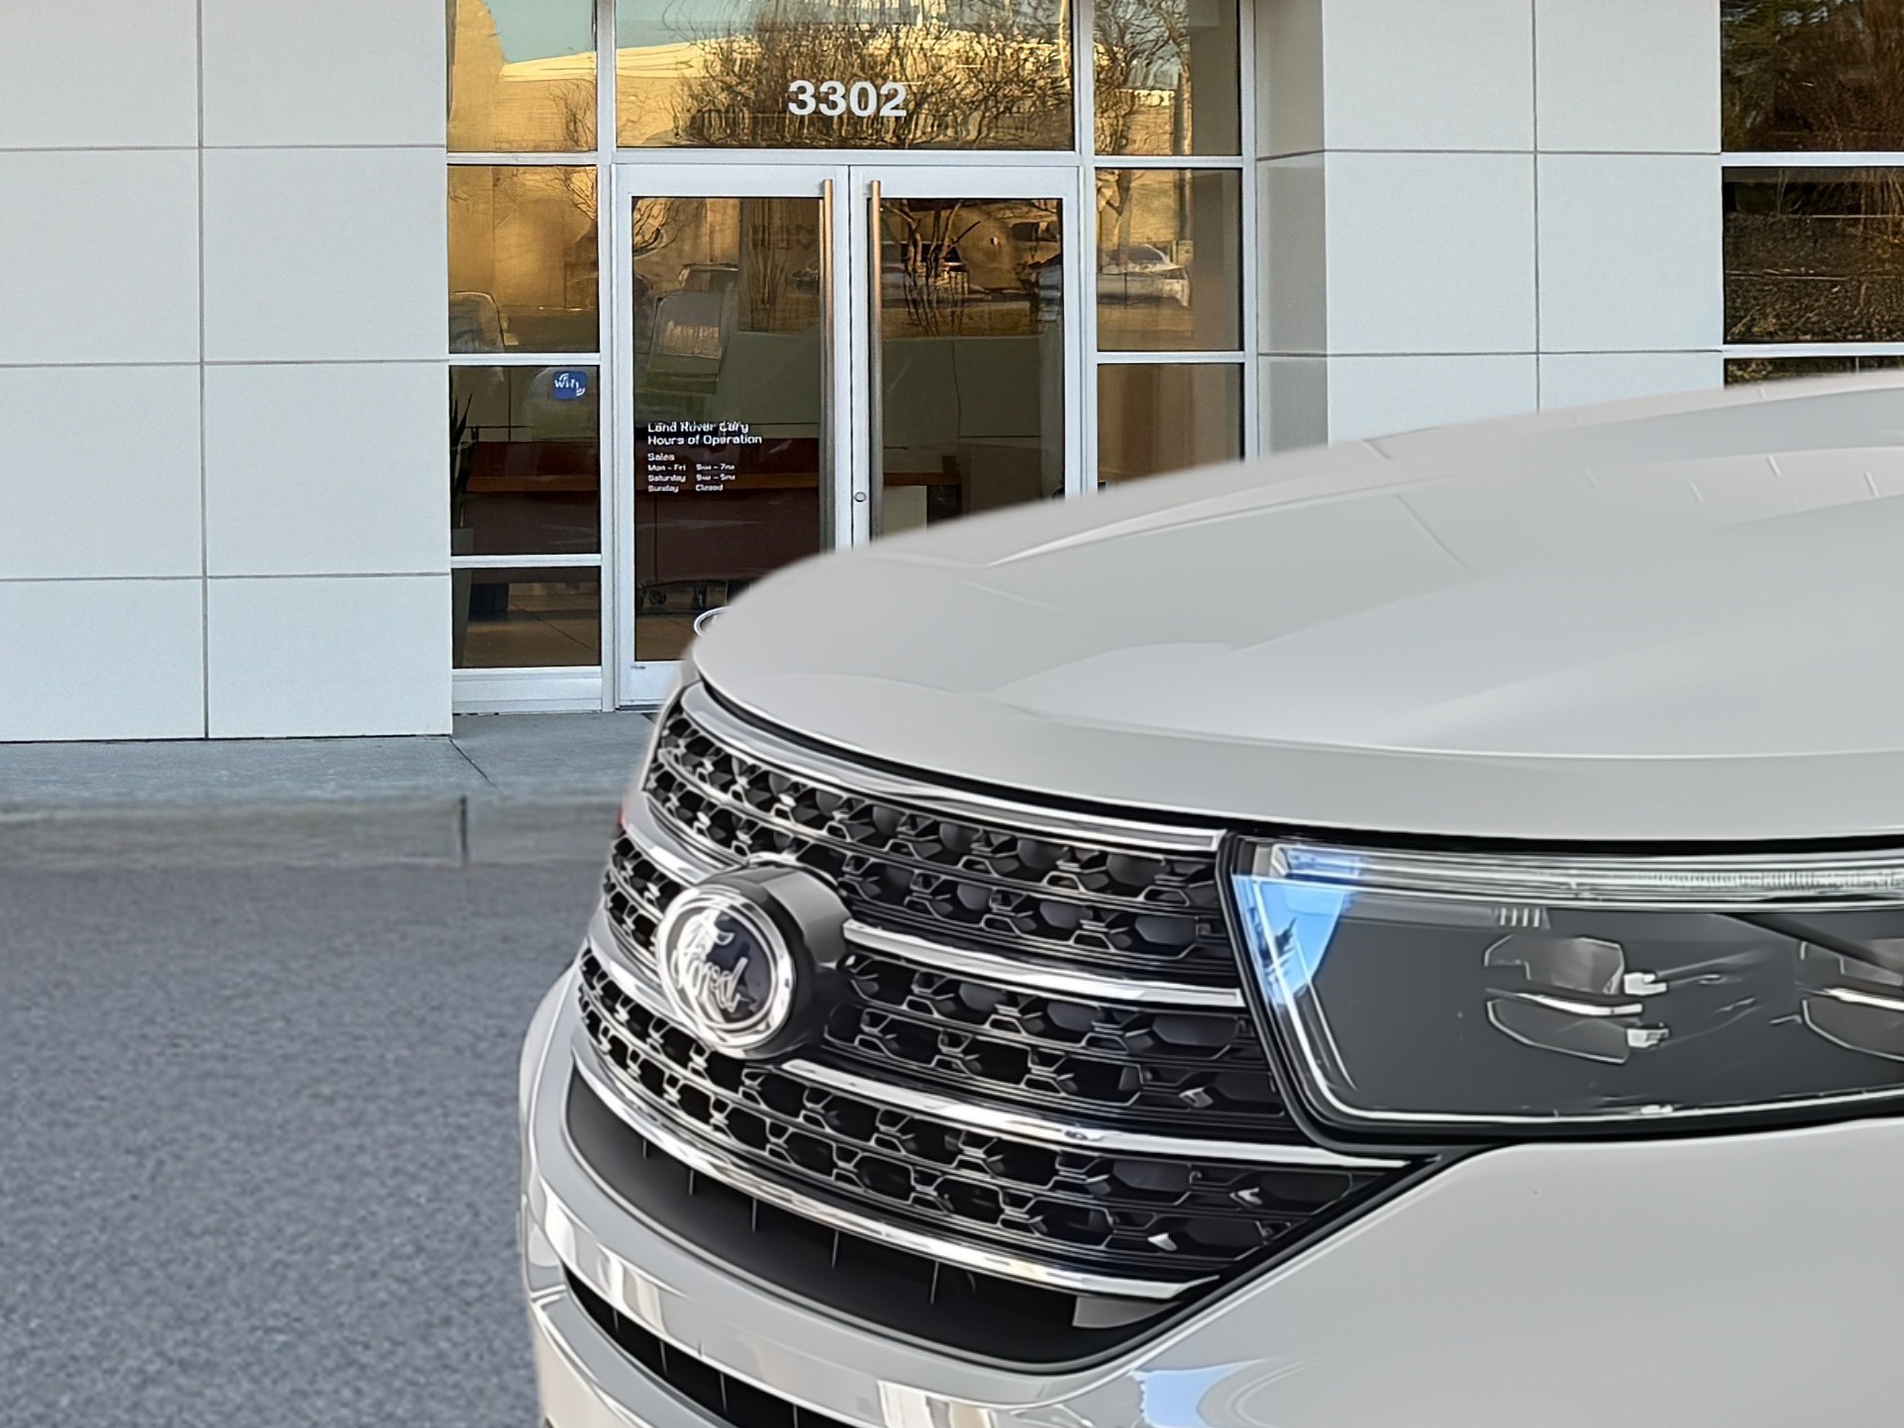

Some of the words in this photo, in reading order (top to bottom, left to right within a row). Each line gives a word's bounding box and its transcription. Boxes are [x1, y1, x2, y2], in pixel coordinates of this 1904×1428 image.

[788, 79, 907, 117] 3302
[647, 435, 685, 445] Hours
[687, 434, 700, 445] of
[703, 434, 762, 446] Operation
[647, 453, 675, 461] Sales
